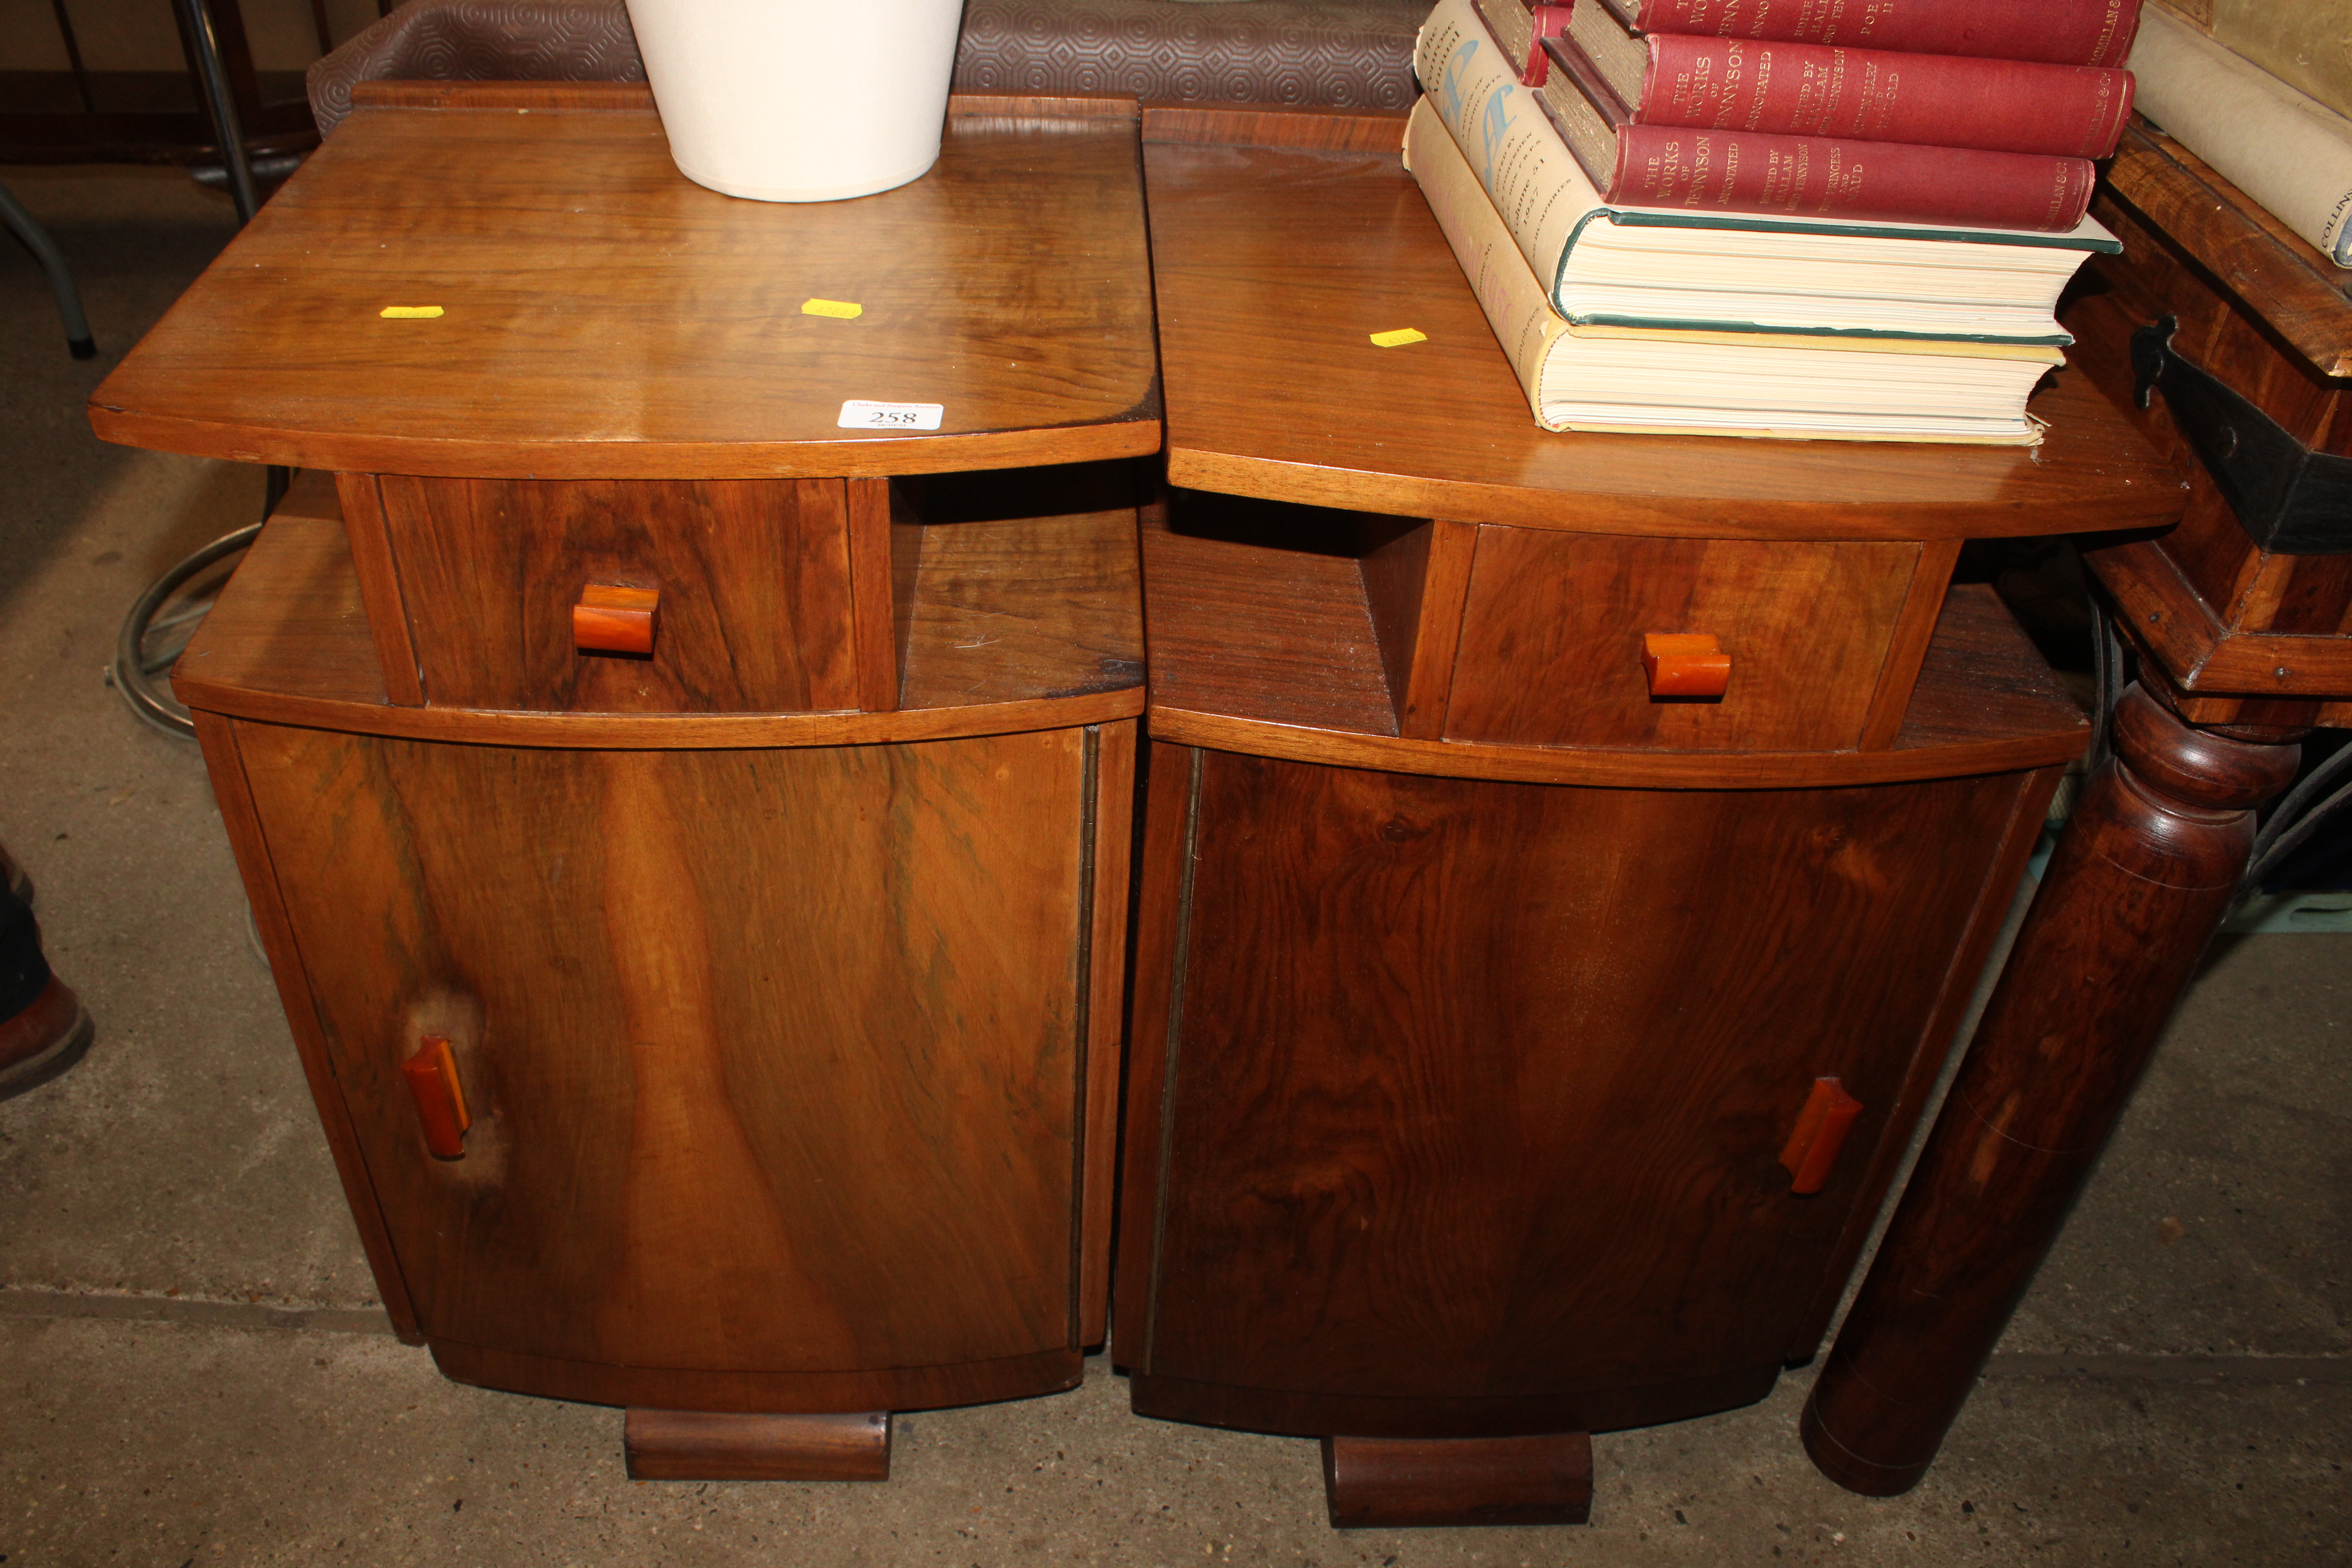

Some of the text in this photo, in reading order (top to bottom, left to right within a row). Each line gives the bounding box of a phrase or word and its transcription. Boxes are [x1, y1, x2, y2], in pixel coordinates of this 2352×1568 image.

[1823, 24, 1837, 46] ORD
[1861, 0, 1878, 34] POE
[1422, 27, 1437, 63] The
[1427, 21, 1455, 93] Penrose
[1434, 31, 1460, 92] Annual
[1463, 91, 1474, 130] REVIEW
[1475, 76, 1483, 89] OF
[1468, 96, 1481, 141] GRAPHIC
[1483, 74, 1501, 94] ARTS
[1673, 73, 1689, 104] THE
[1686, 57, 1710, 118] WORKS
[1710, 83, 1719, 98] OF
[1745, 51, 1771, 130] ANNOTATED
[1791, 61, 1814, 127] EDITED BY
[1806, 67, 1828, 125] HALLAM
[1818, 49, 1844, 135] ORD TENNYSON
[2098, 88, 2109, 98] &
[1496, 135, 1515, 192] EDITED BY
[1503, 132, 1532, 190] FISHENDEN
[1645, 157, 1659, 188] THE
[1657, 142, 1679, 198] WORKS
[1681, 165, 1690, 181] OF
[1685, 136, 1710, 205] TENNYSON
[1718, 143, 1738, 204] ANNOTATED
[1760, 149, 1779, 204] EDITED BY
[1776, 155, 1793, 202] HALLAM
[1786, 144, 1808, 211] LORD TENNYSON
[1826, 147, 1840, 194] PRINCESS
[1839, 174, 1849, 193] AND
[1846, 164, 1863, 202] MAUD
[2056, 174, 2067, 184] &
[1514, 158, 1544, 235] Volume 51
[1523, 187, 1538, 226] 1957
[1535, 178, 1572, 241] HUMPHRIES
[868, 412, 917, 424] 258
